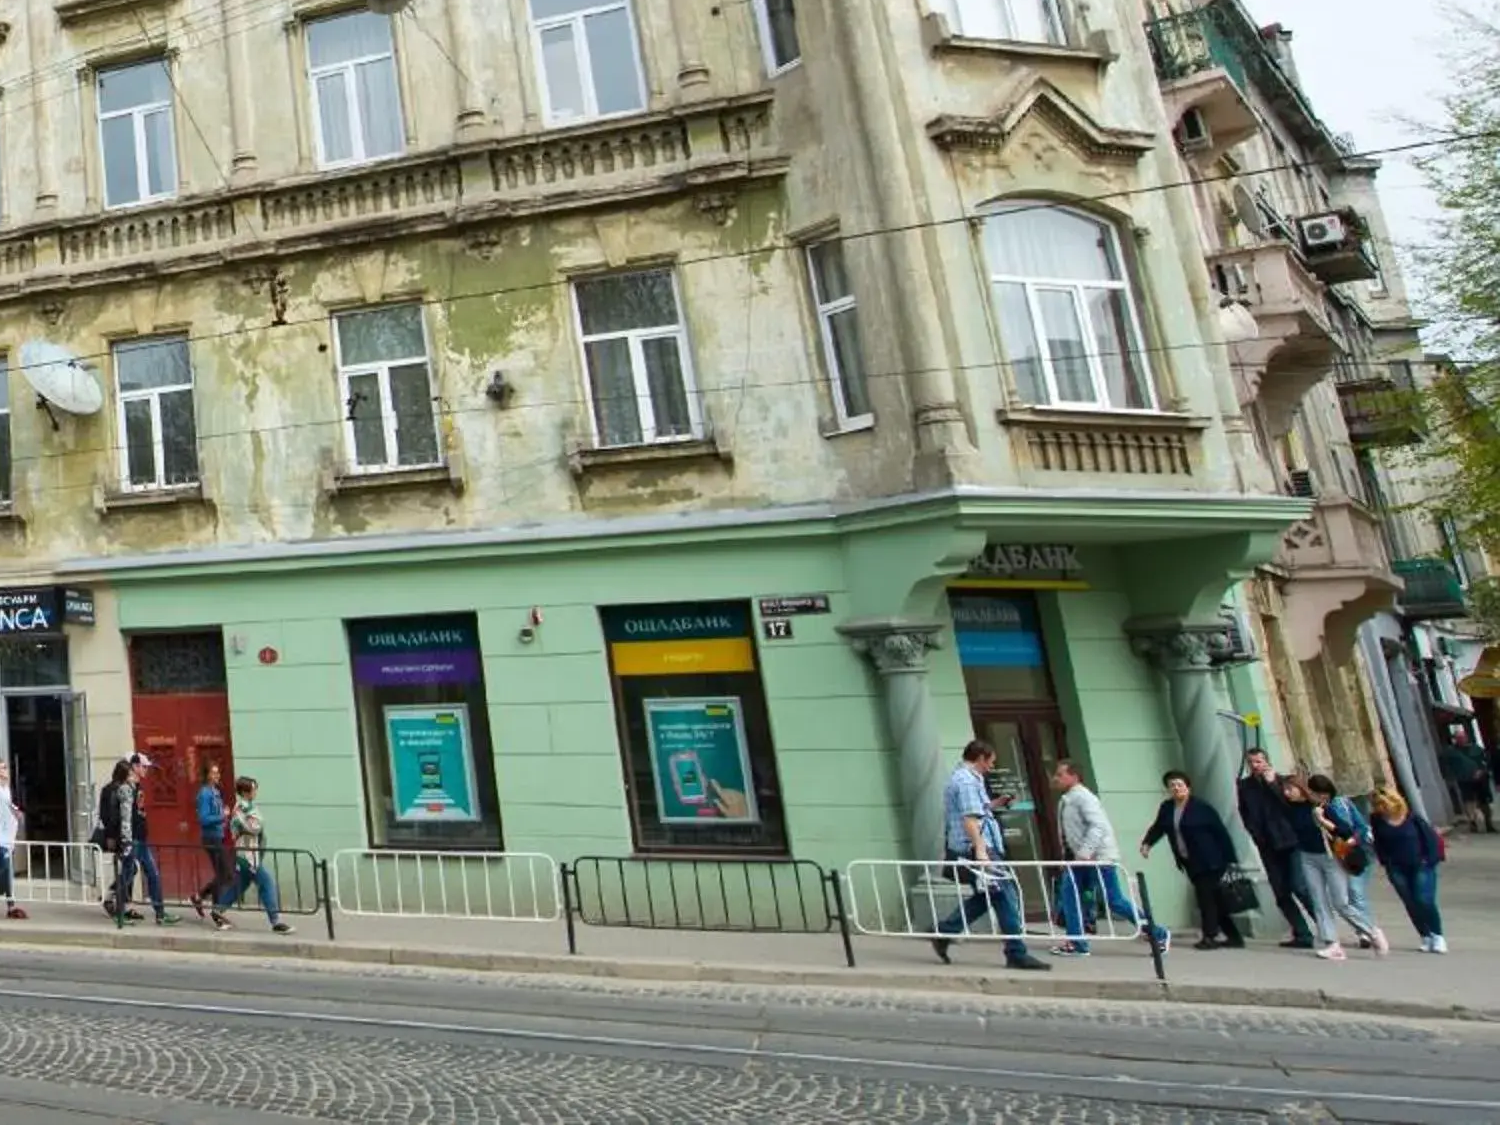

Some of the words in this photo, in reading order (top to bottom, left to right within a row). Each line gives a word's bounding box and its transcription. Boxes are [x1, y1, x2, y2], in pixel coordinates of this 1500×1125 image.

[968, 545, 1084, 573] АДБАНК
[624, 616, 732, 635] ОЩАДБАНК
[768, 622, 786, 636] 17
[367, 629, 464, 649] ОЩАДБАНК
